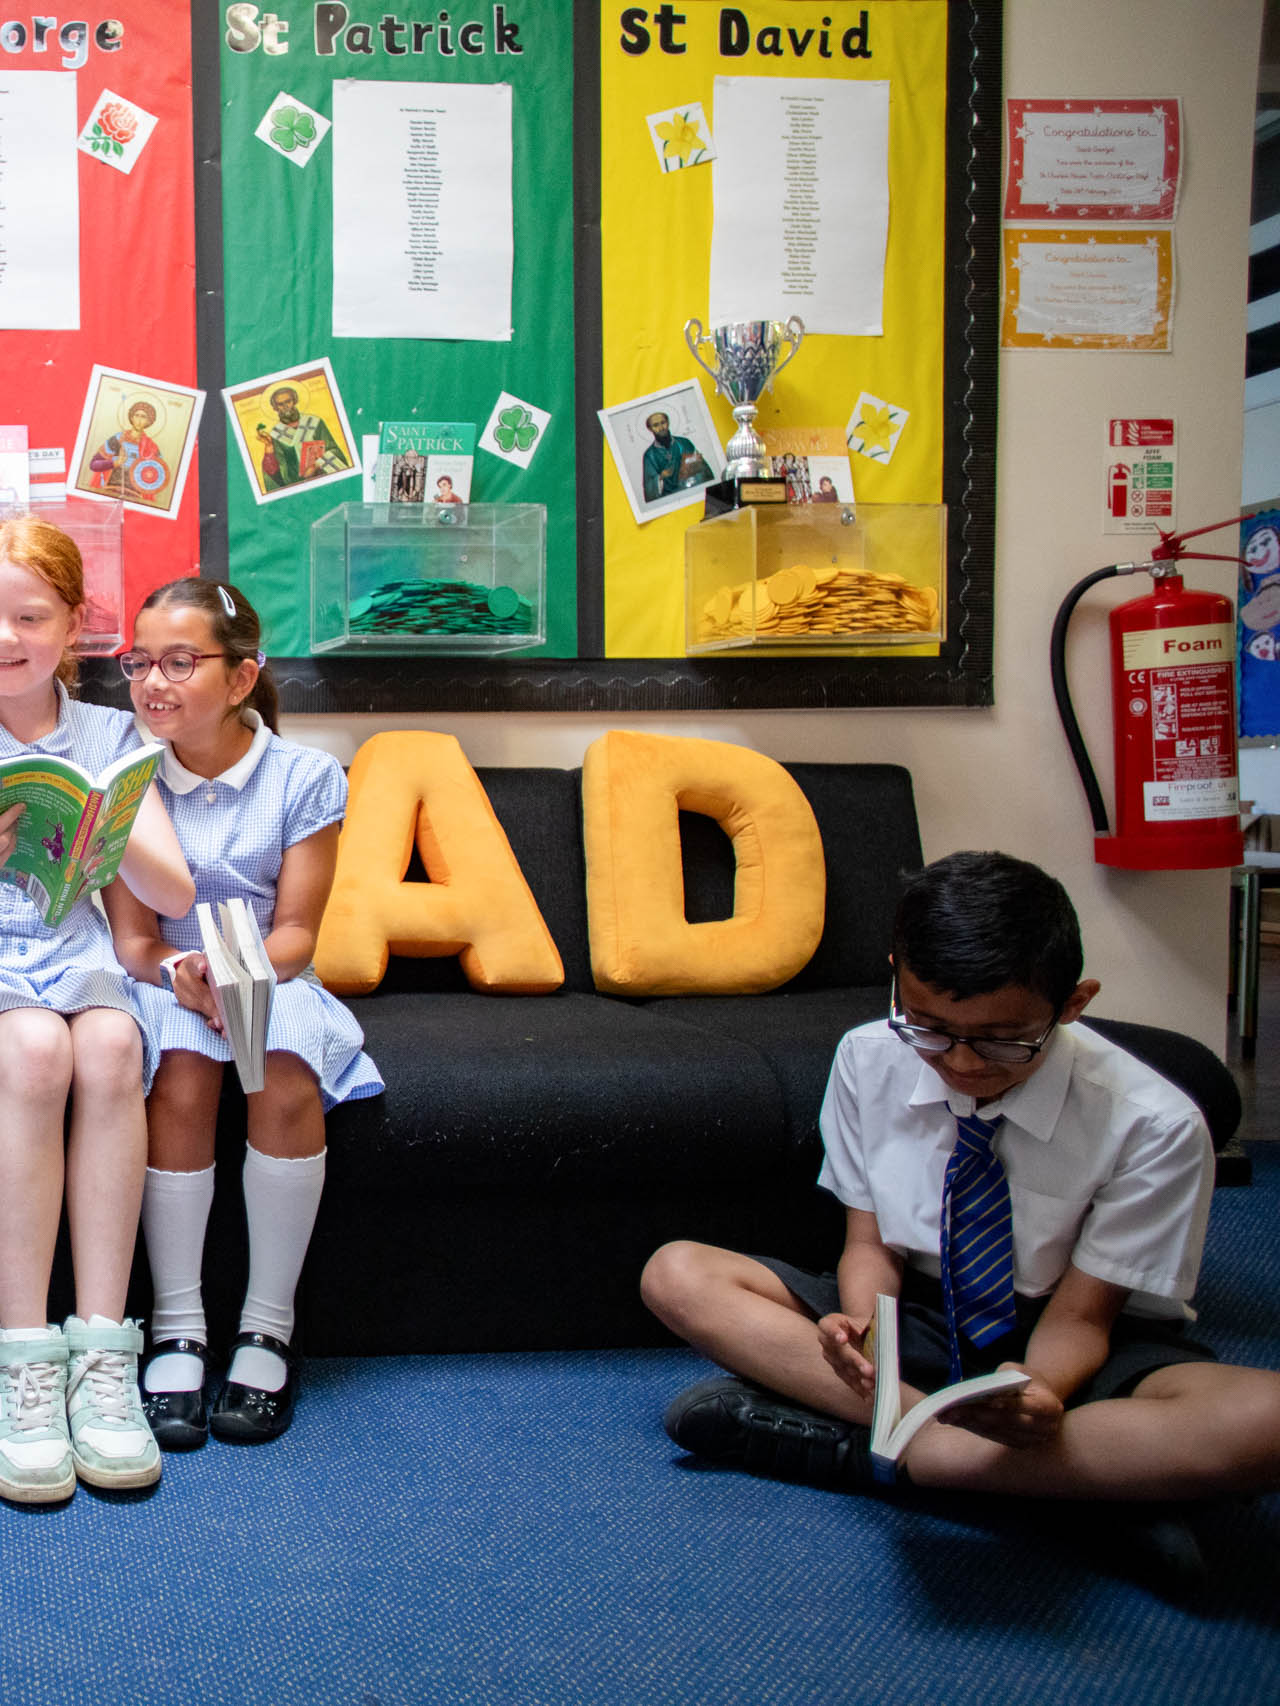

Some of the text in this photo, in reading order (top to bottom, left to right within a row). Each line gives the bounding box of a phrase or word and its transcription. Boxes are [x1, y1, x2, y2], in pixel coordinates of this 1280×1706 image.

[225, 3, 524, 57] St Patrick
[620, 4, 873, 59] St David
[1043, 125, 1134, 141] Congratulations
[397, 438, 464, 452] PATRICK
[1163, 639, 1223, 654] Foam
